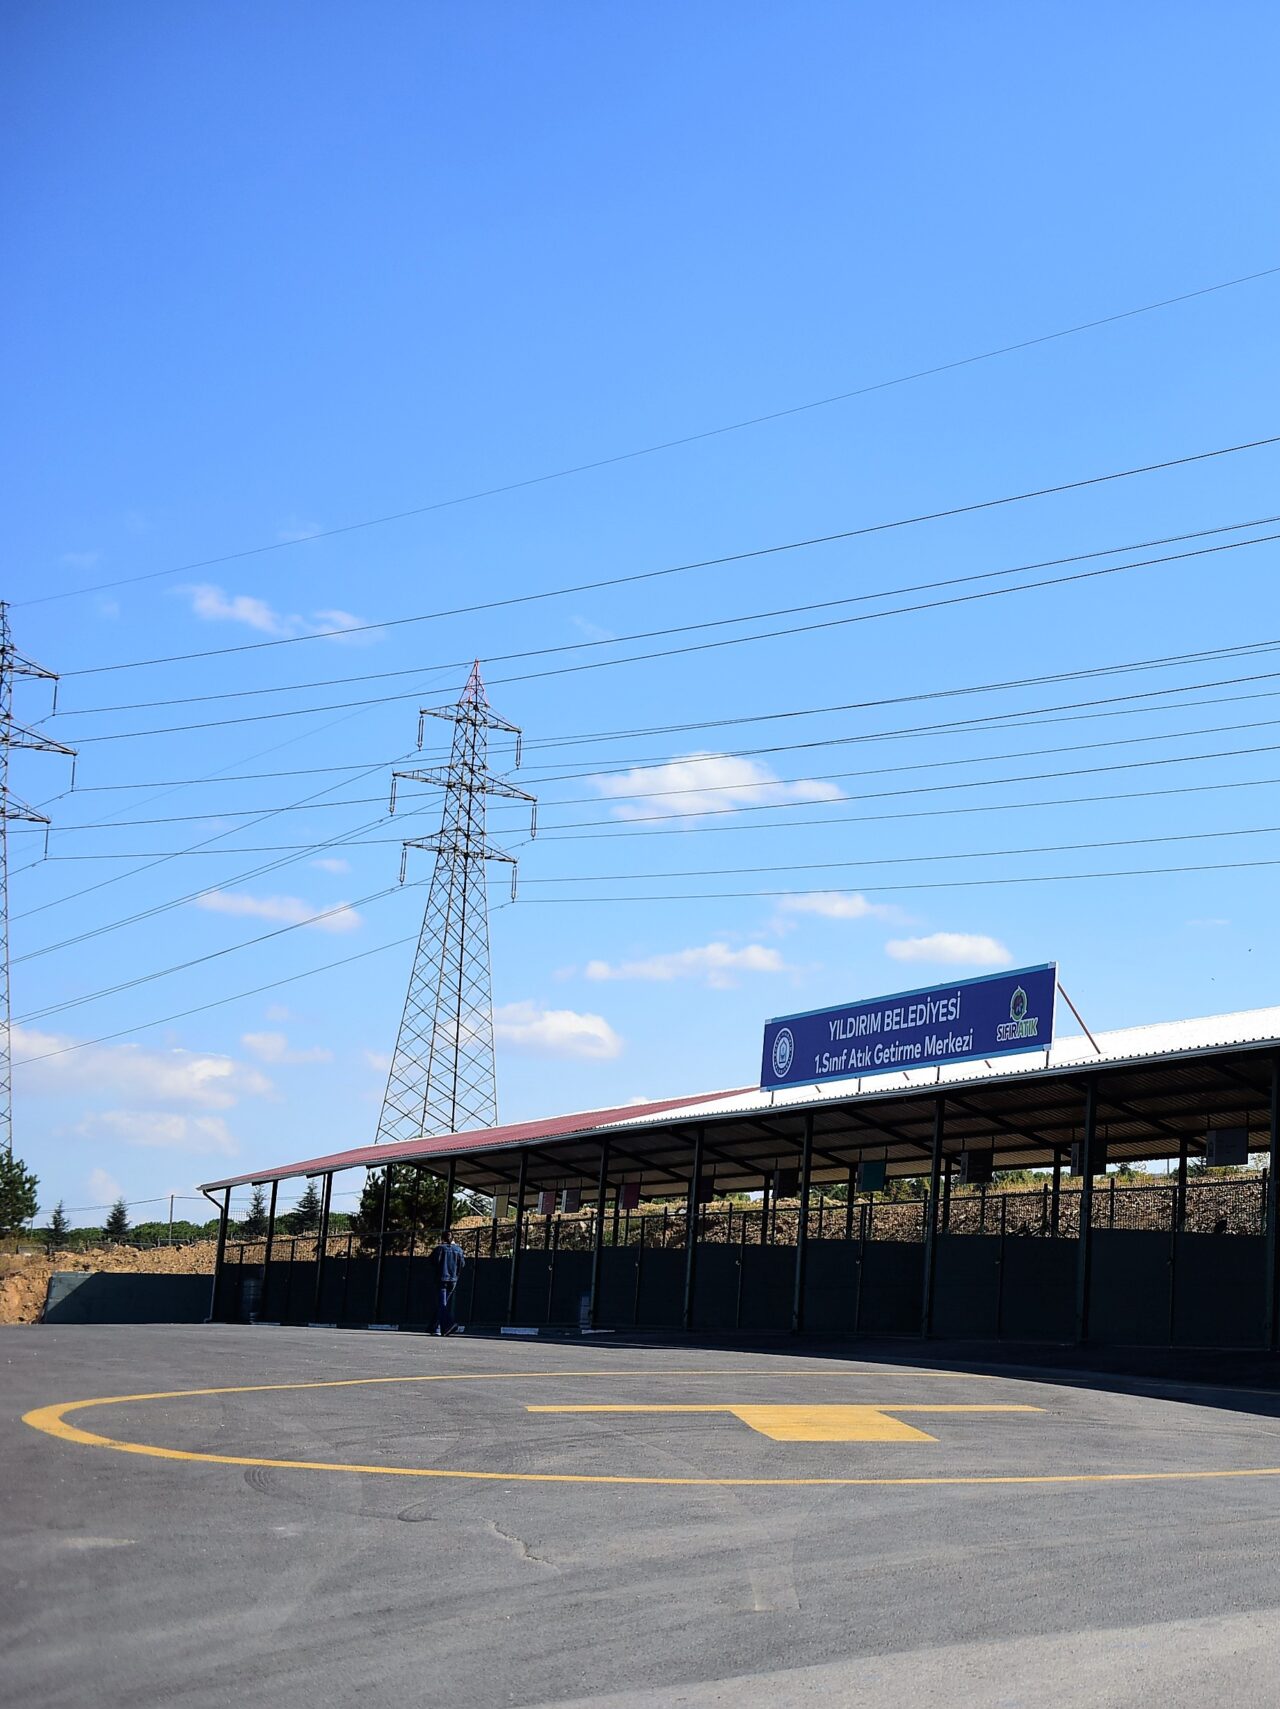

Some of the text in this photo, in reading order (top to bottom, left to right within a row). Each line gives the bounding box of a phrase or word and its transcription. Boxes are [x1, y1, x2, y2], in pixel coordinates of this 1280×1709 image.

[829, 990, 961, 1041] YILDIRIM BELEDİYESİ
[814, 1049, 847, 1074] 1.Sınıf
[848, 1046, 871, 1069] Atık
[874, 1041, 922, 1064] Getirme
[924, 1029, 973, 1057] Merkezi
